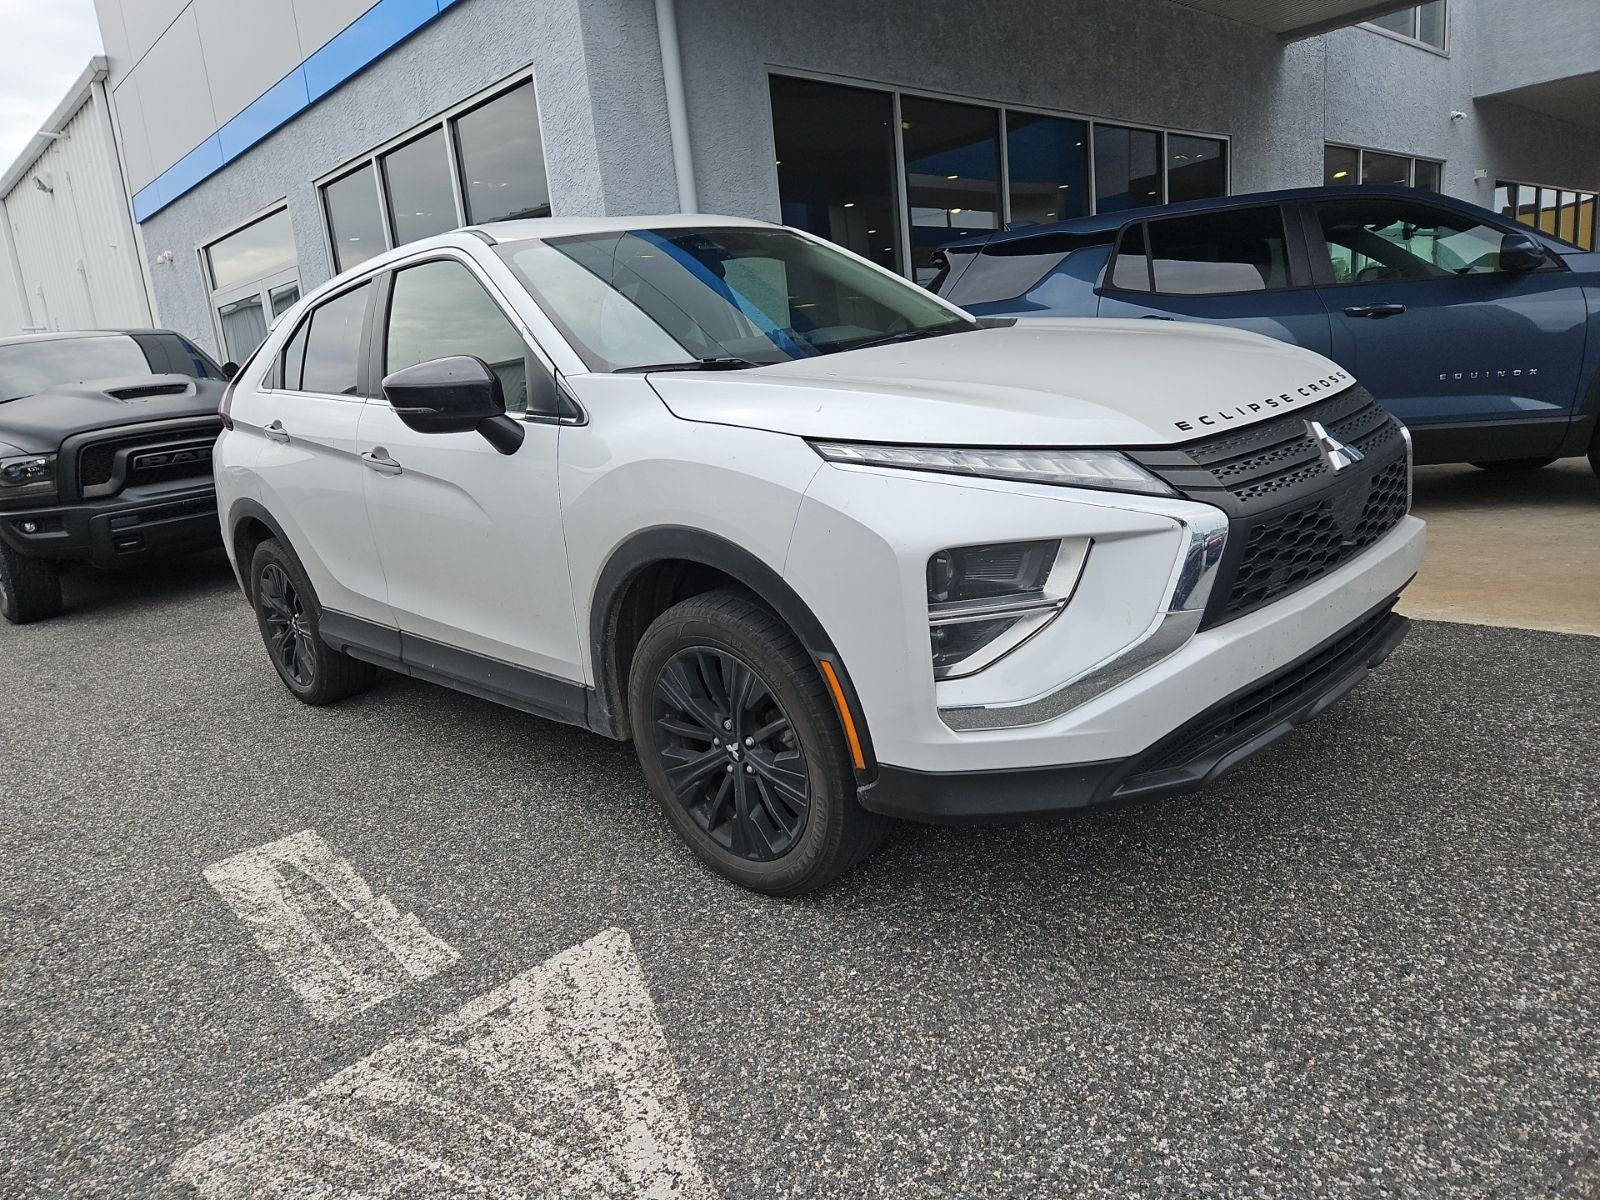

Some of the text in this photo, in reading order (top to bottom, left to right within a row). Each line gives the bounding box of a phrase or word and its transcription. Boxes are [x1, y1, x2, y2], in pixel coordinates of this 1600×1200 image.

[1439, 368, 1538, 381] EQUINOX
[1174, 371, 1347, 431] ECLIPSE CROSS
